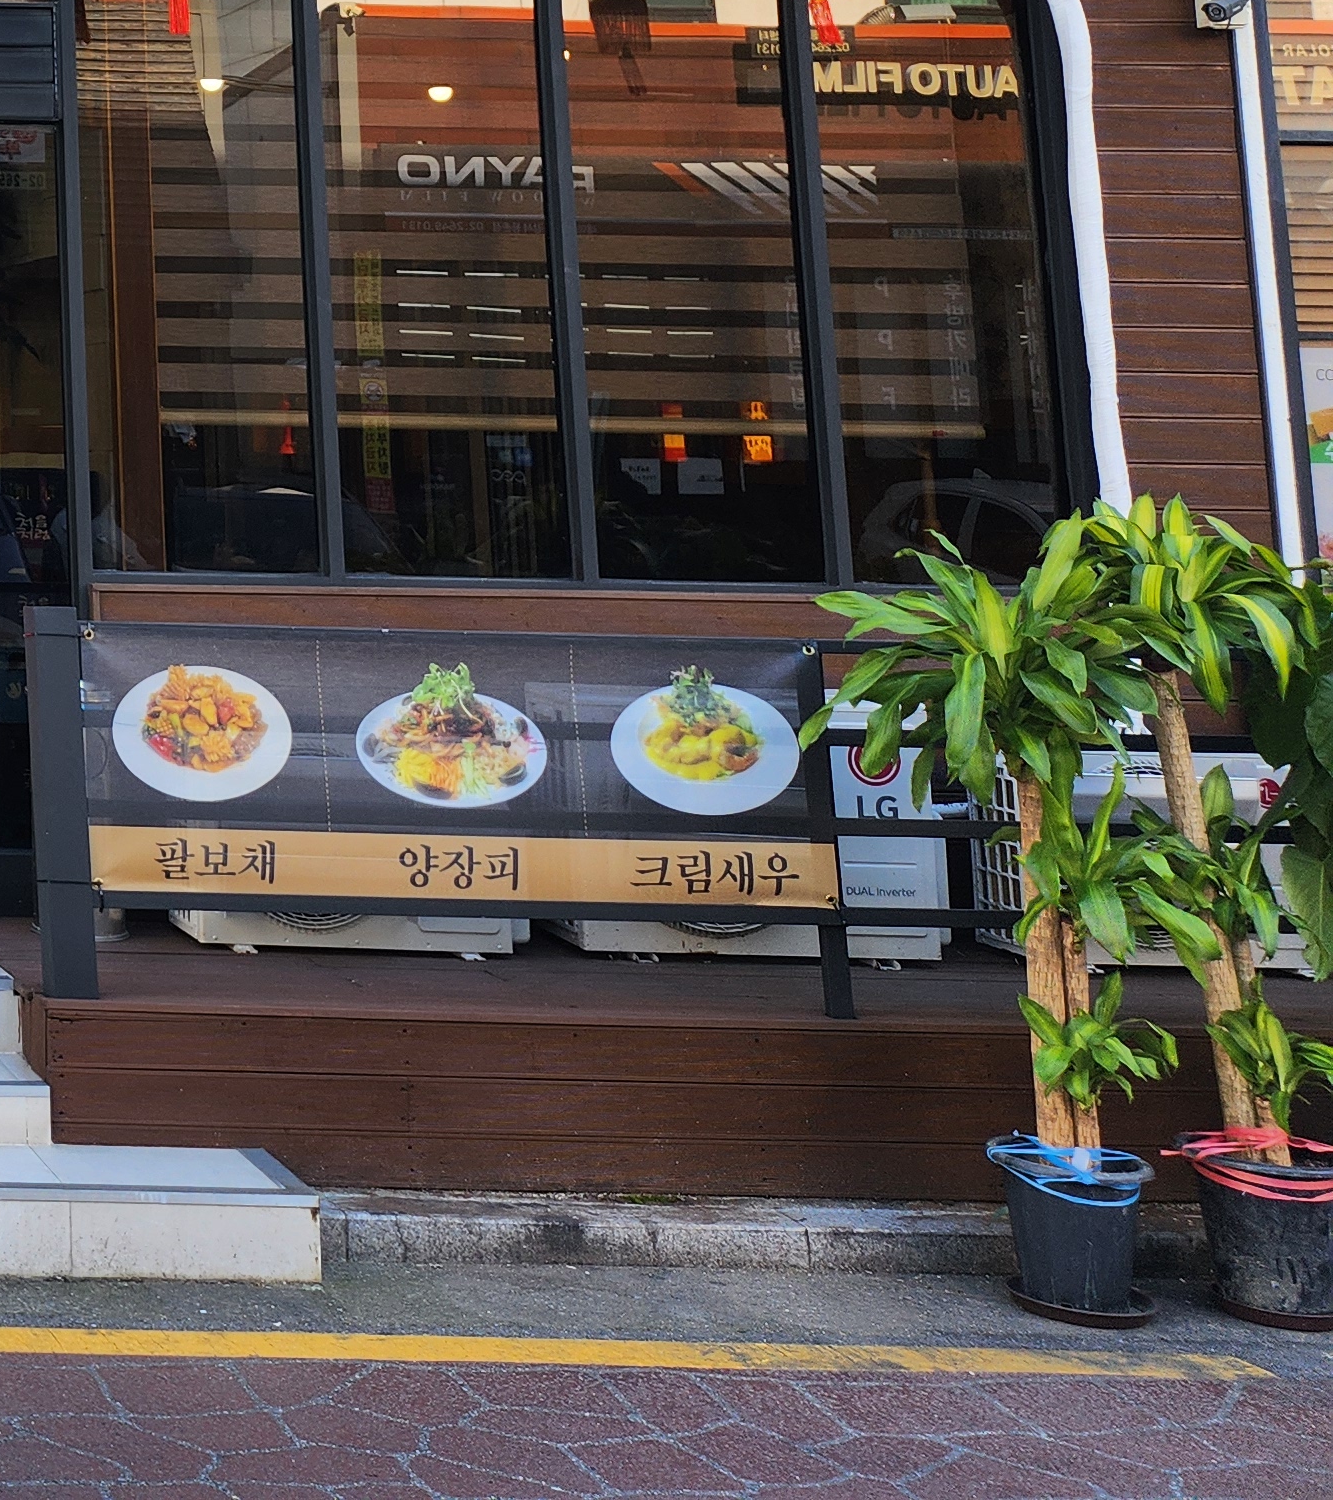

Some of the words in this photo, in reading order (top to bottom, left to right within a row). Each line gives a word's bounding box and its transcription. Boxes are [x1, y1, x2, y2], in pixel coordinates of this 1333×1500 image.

[856, 795, 899, 819] LG
[152, 838, 278, 886] 팔보채
[398, 843, 521, 892] 양장피
[630, 848, 801, 896] 크림새우
[846, 886, 874, 897] DUAL
[876, 887, 917, 897] Inverter
